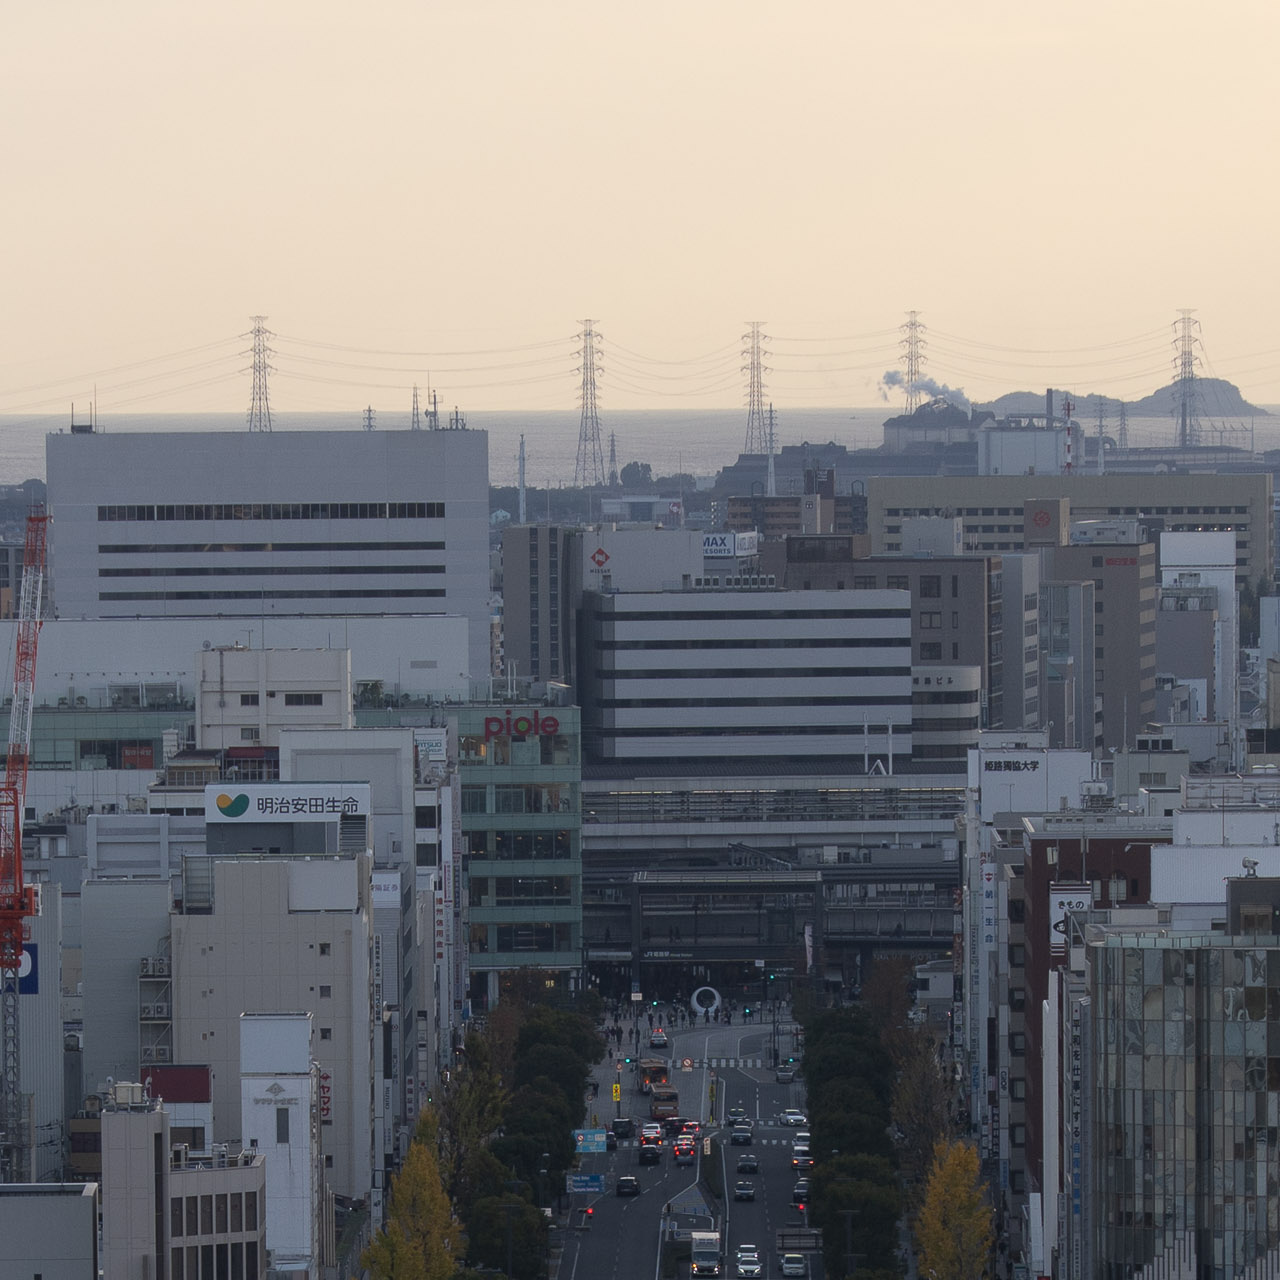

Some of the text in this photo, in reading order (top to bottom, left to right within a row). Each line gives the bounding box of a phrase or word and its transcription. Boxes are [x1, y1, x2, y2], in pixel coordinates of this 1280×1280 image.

[485, 709, 560, 742] piole
[984, 760, 1040, 772] 姫路獨協大学
[257, 796, 359, 814] 明治安田生命
[985, 890, 994, 943] 第一生命
[1058, 901, 1084, 909] きもの
[320, 1084, 331, 1117] ヤマサ
